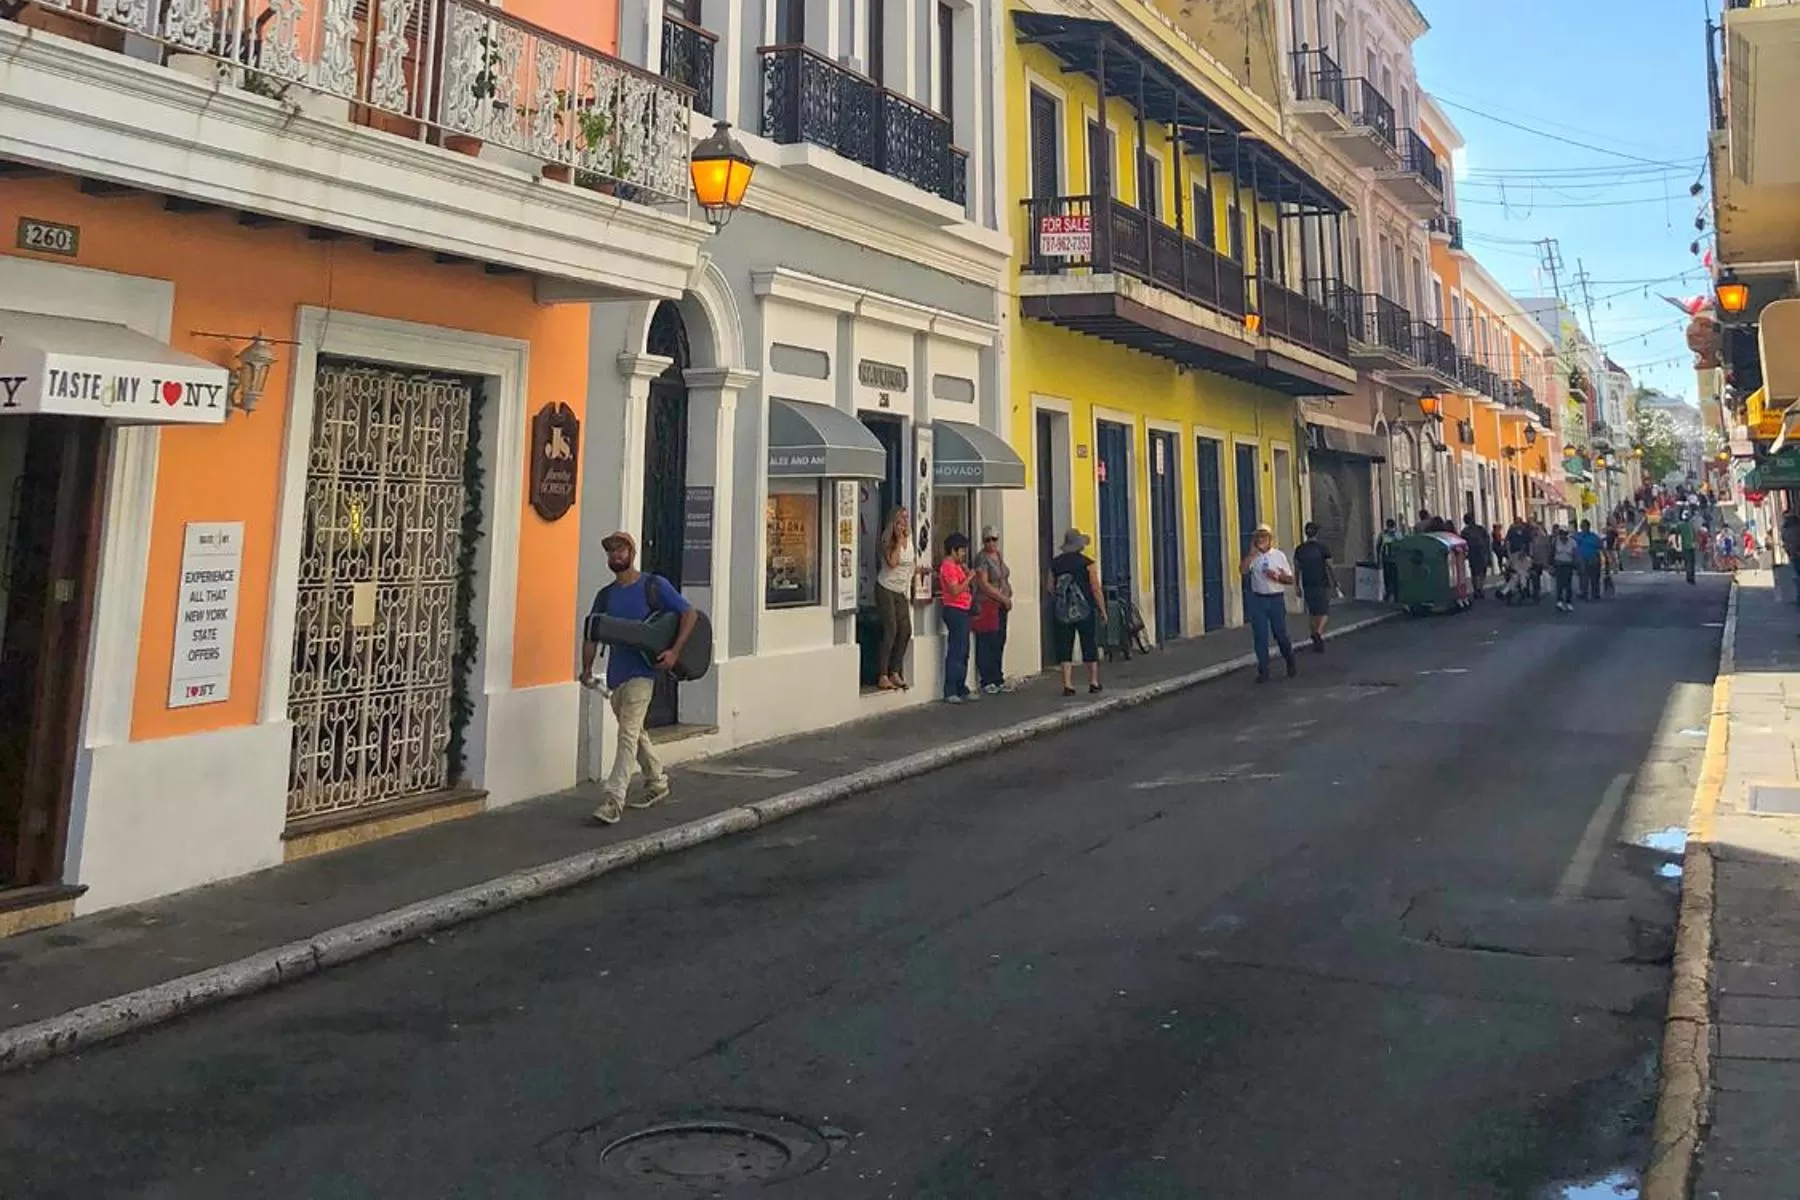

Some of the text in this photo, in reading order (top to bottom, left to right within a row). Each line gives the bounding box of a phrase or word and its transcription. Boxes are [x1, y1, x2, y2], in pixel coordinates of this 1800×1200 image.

[1042, 217, 1090, 232] FOR SALE
[31, 226, 67, 248] 260
[49, 369, 141, 403] TASTE NY
[150, 379, 223, 408] I NY
[790, 456, 809, 465] AND
[185, 569, 234, 584] EXPERIENCE
[189, 589, 228, 602] ALL THAT
[185, 608, 229, 623] NEW YORK
[192, 628, 218, 642] STATE
[188, 647, 220, 662] OFFERS
